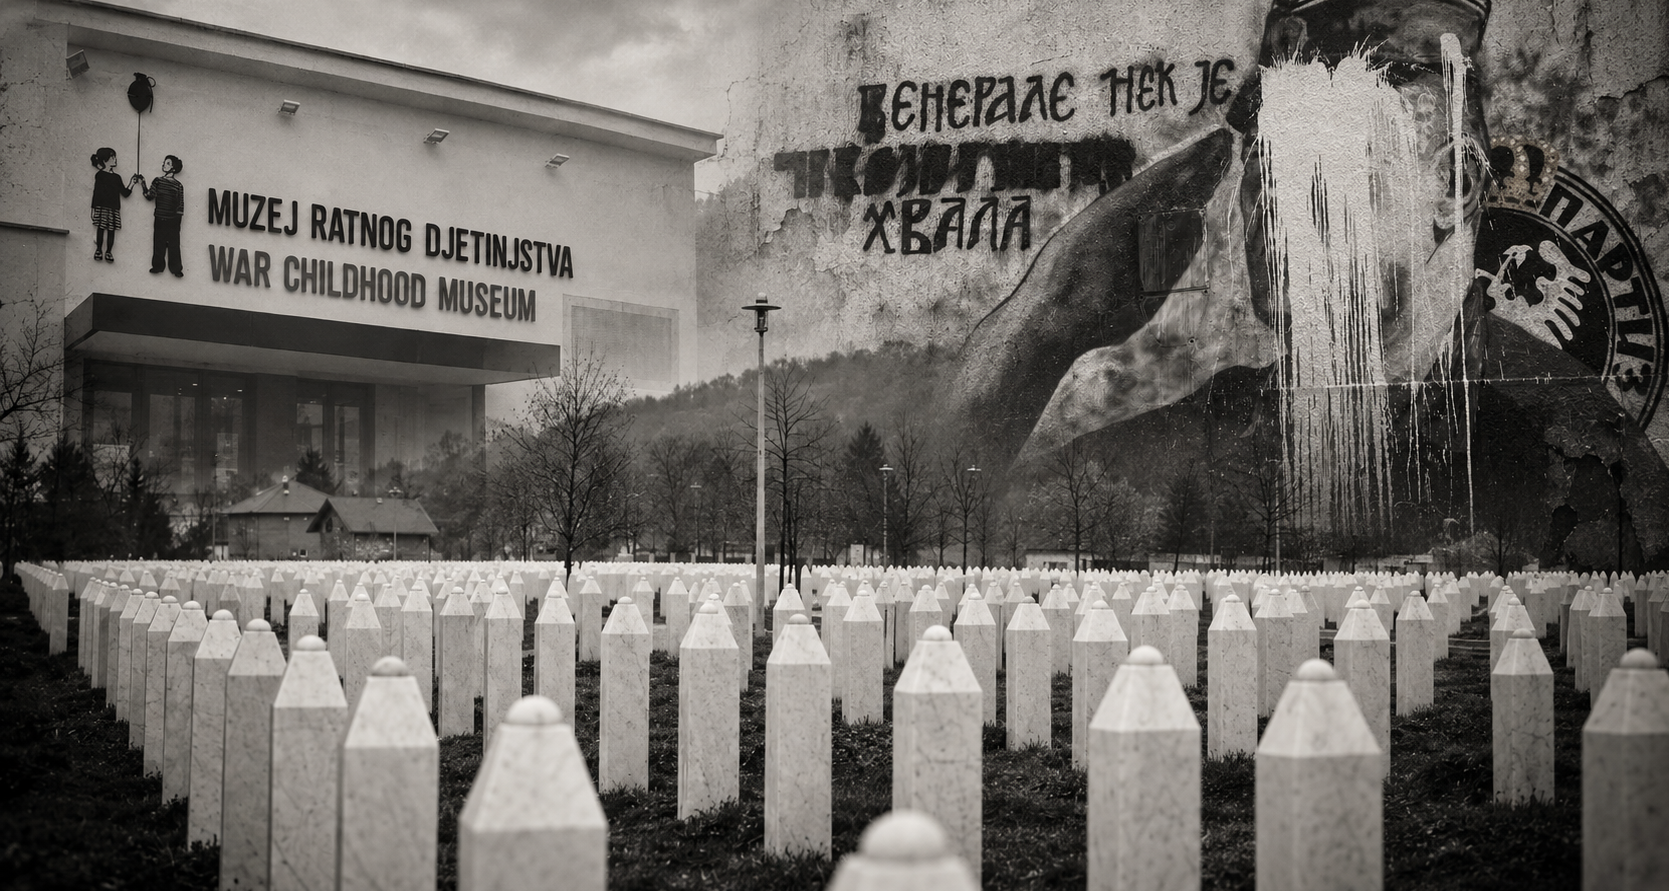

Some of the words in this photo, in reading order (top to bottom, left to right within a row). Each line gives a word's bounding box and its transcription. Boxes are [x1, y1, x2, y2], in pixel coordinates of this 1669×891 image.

[207, 188, 299, 236] MUZEJ
[310, 204, 412, 253] RATNOG
[424, 223, 575, 279] DJETINJSTVA
[863, 195, 1031, 255] ХВАЛА
[208, 244, 272, 288] WAR
[283, 256, 427, 309] CHILDHOOD
[438, 277, 537, 323] MUSEUM
